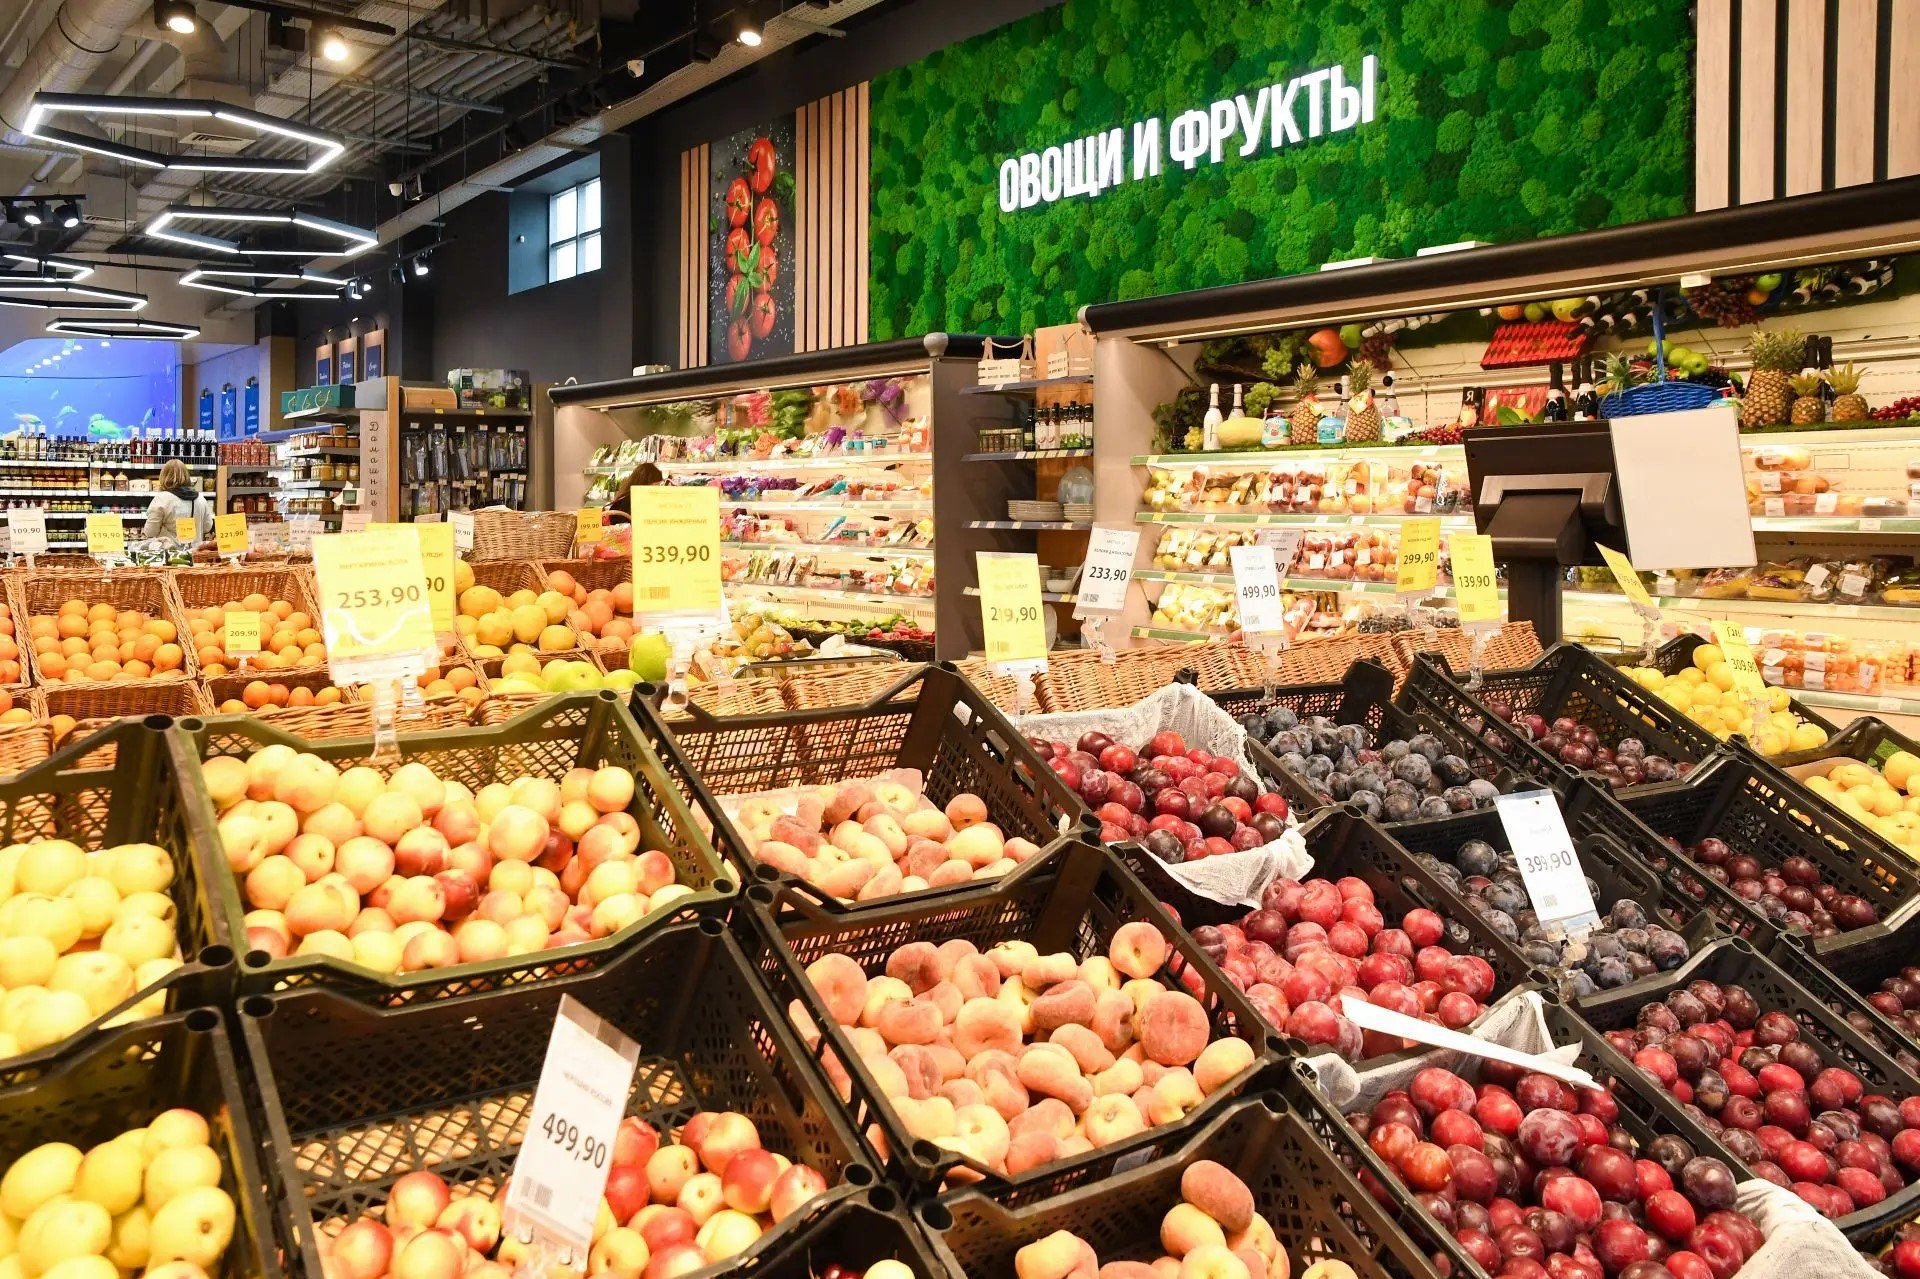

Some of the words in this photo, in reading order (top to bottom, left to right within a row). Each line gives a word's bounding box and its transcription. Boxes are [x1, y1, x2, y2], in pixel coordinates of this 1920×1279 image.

[1000, 128, 1124, 213] ОВОЩИ
[1133, 117, 1161, 181] И
[1169, 54, 1378, 170] ФРУКТЫ
[642, 545, 710, 565] 339,90
[1403, 552, 1435, 565] 299,90
[1089, 566, 1127, 581] 233,90
[1459, 575, 1490, 589] 139,90
[337, 585, 420, 609] 253,90
[1242, 584, 1276, 599] 499,90
[1524, 850, 1572, 874] 399,90
[542, 1112, 606, 1169] 499,90
